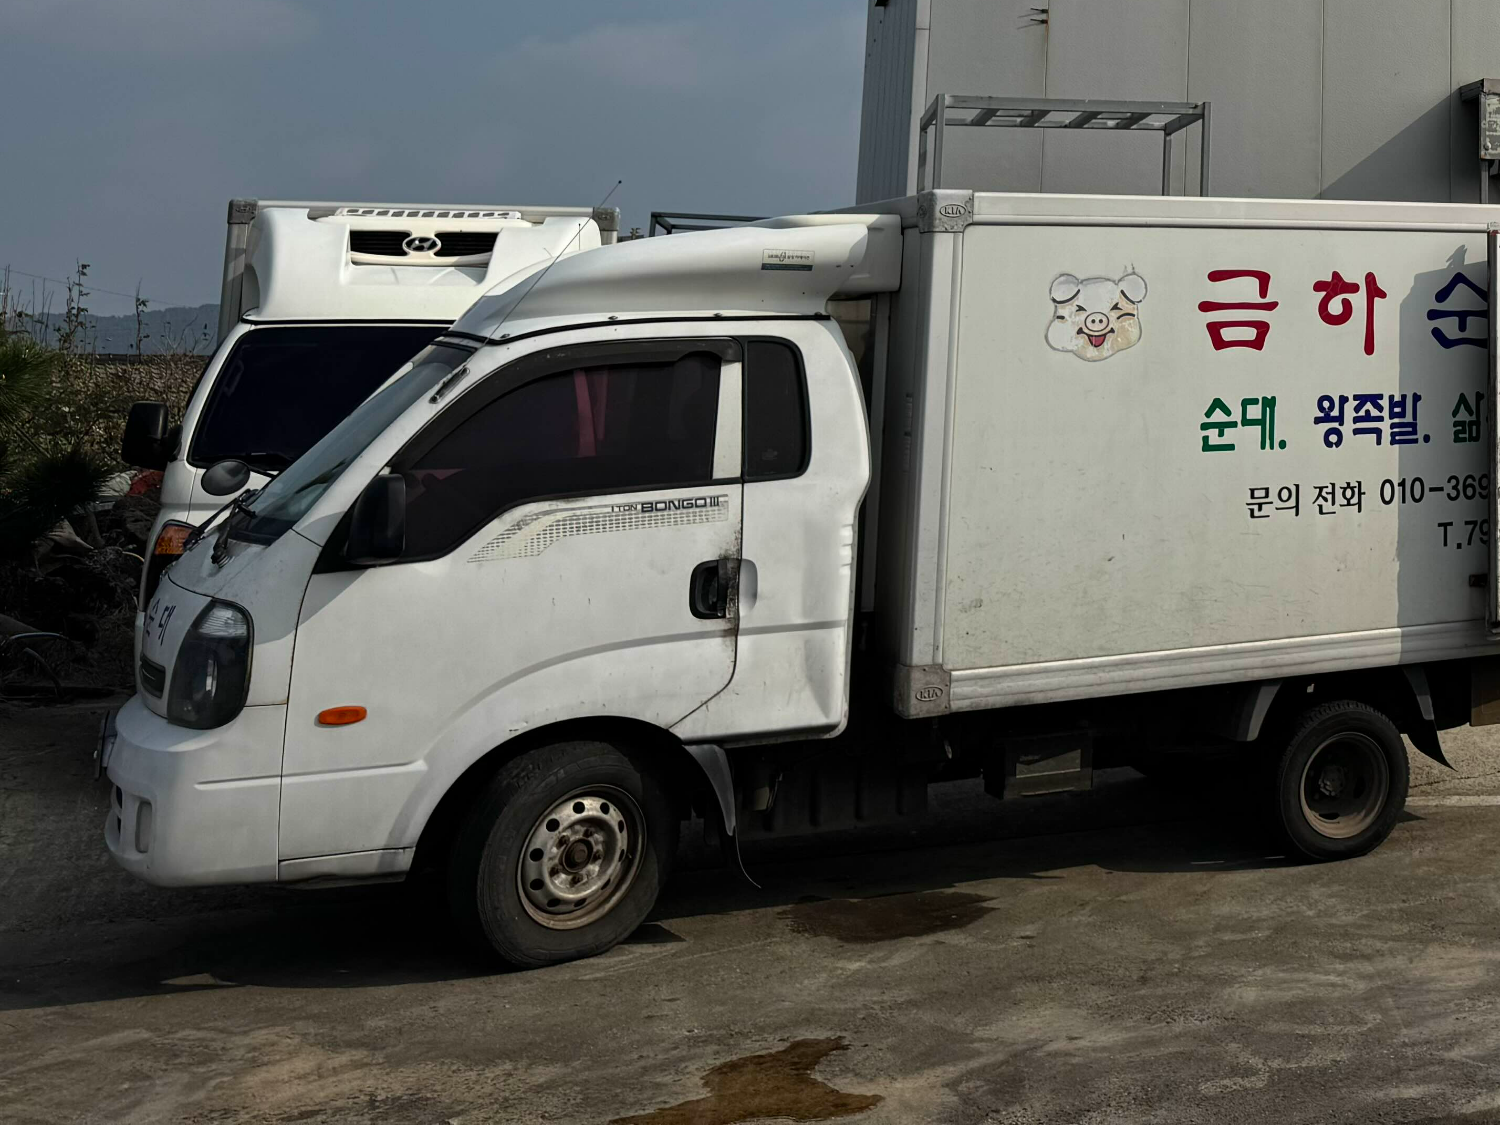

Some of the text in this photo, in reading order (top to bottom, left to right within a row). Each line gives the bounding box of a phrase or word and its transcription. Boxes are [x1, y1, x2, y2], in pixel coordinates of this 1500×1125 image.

[944, 206, 962, 215] KIA
[1200, 395, 1287, 452] 순대.
[1314, 392, 1431, 448] 왕족발.
[641, 497, 707, 513] BONGO
[709, 496, 720, 507] III
[1246, 483, 1300, 518] 문의
[1312, 481, 1366, 515] 전화
[920, 688, 939, 699] KIA
